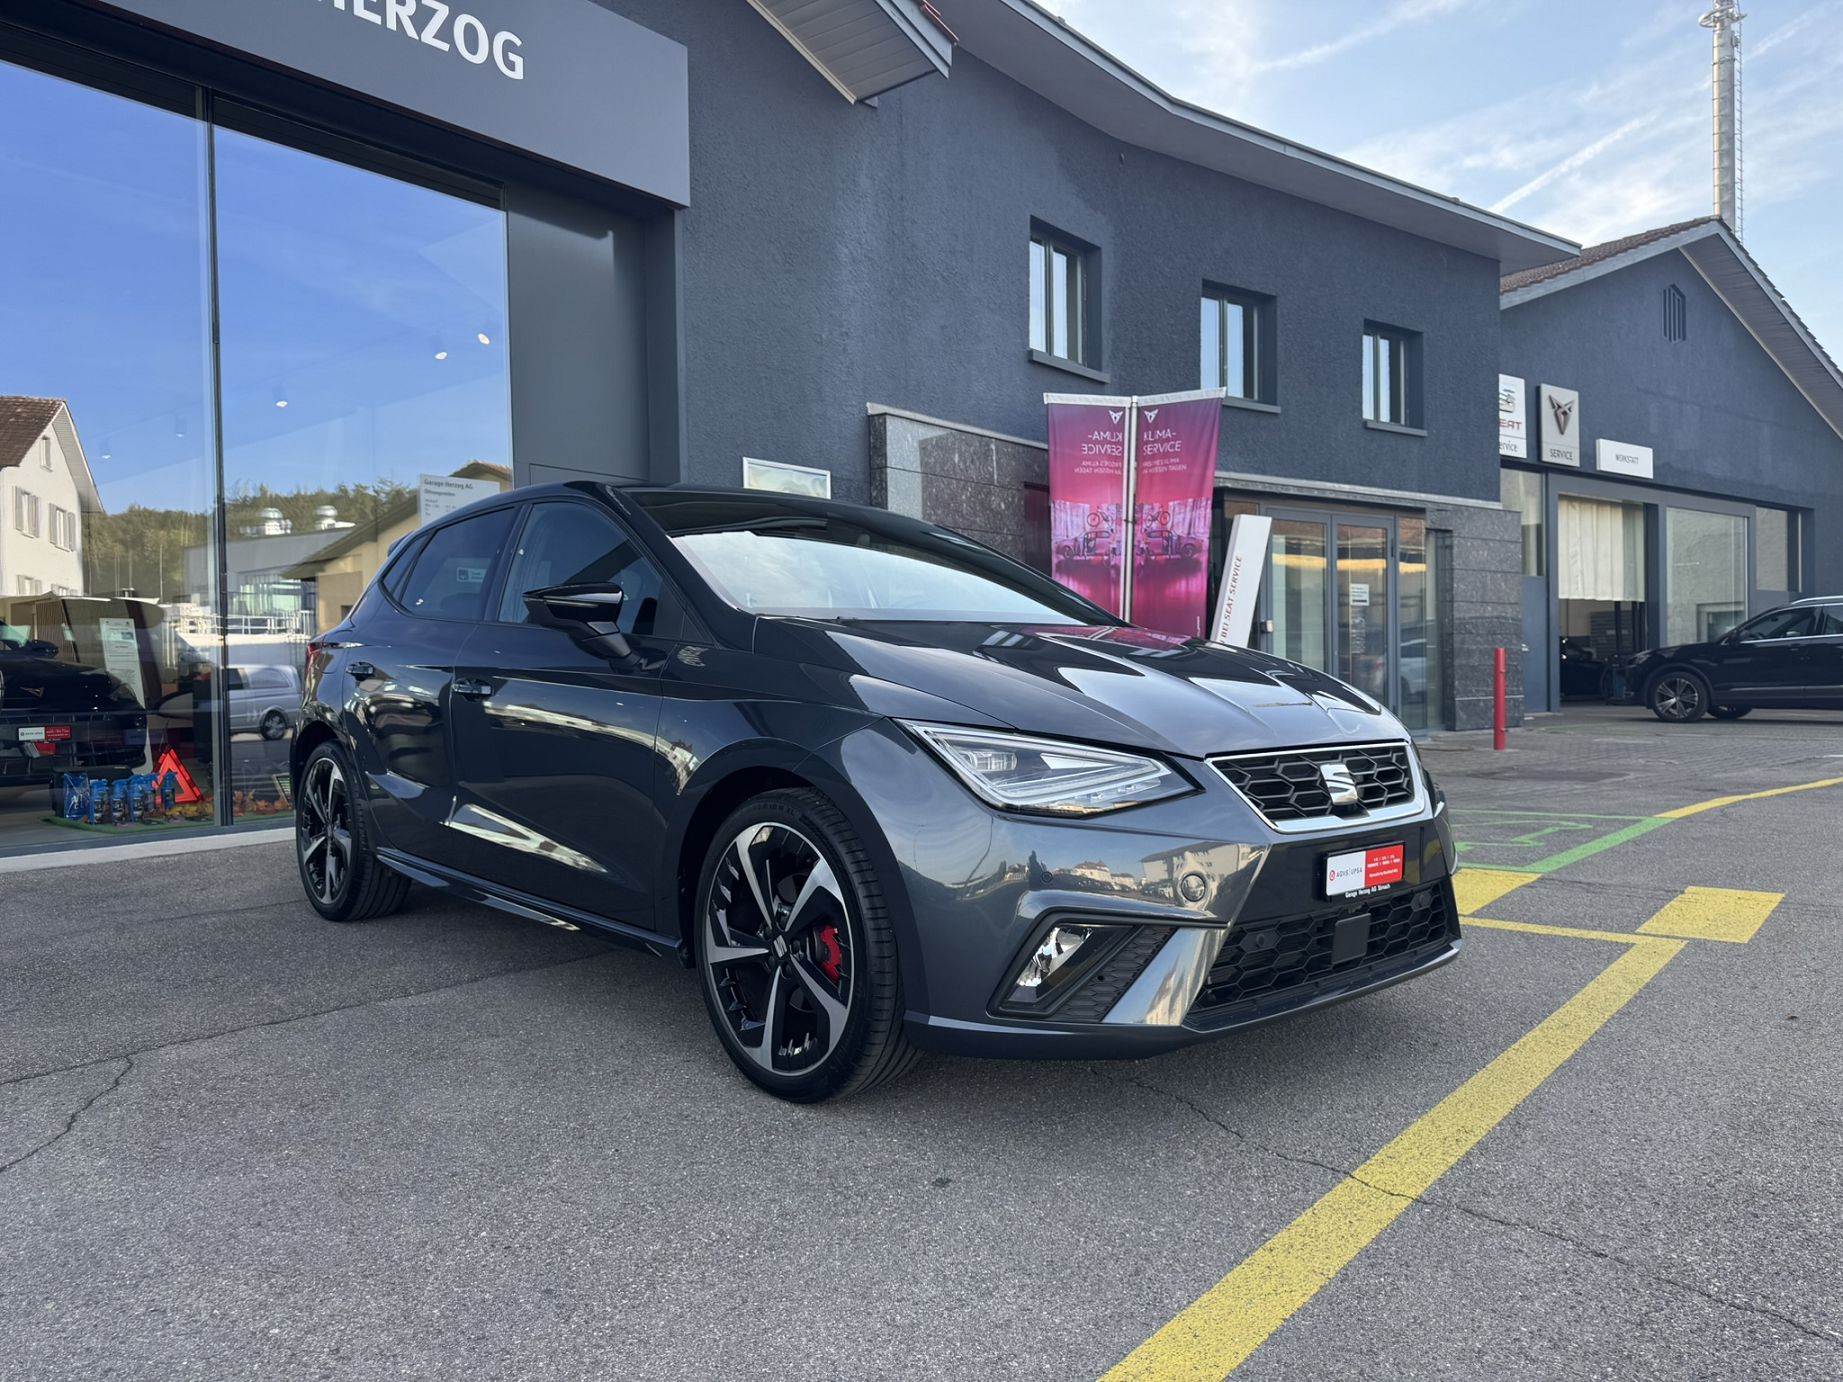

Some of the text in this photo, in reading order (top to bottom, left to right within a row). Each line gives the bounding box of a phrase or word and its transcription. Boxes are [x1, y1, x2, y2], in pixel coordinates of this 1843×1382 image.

[317, 0, 525, 80] RZOG
[1499, 419, 1523, 431] EAT
[1143, 428, 1177, 442] KLIMA-
[1143, 440, 1182, 456] SERVICE
[1499, 440, 1518, 452] ervice
[1549, 448, 1574, 461] SERVICE
[424, 479, 444, 488] Garage
[1223, 598, 1235, 621] SEAT
[1229, 555, 1243, 596] SERVICE
